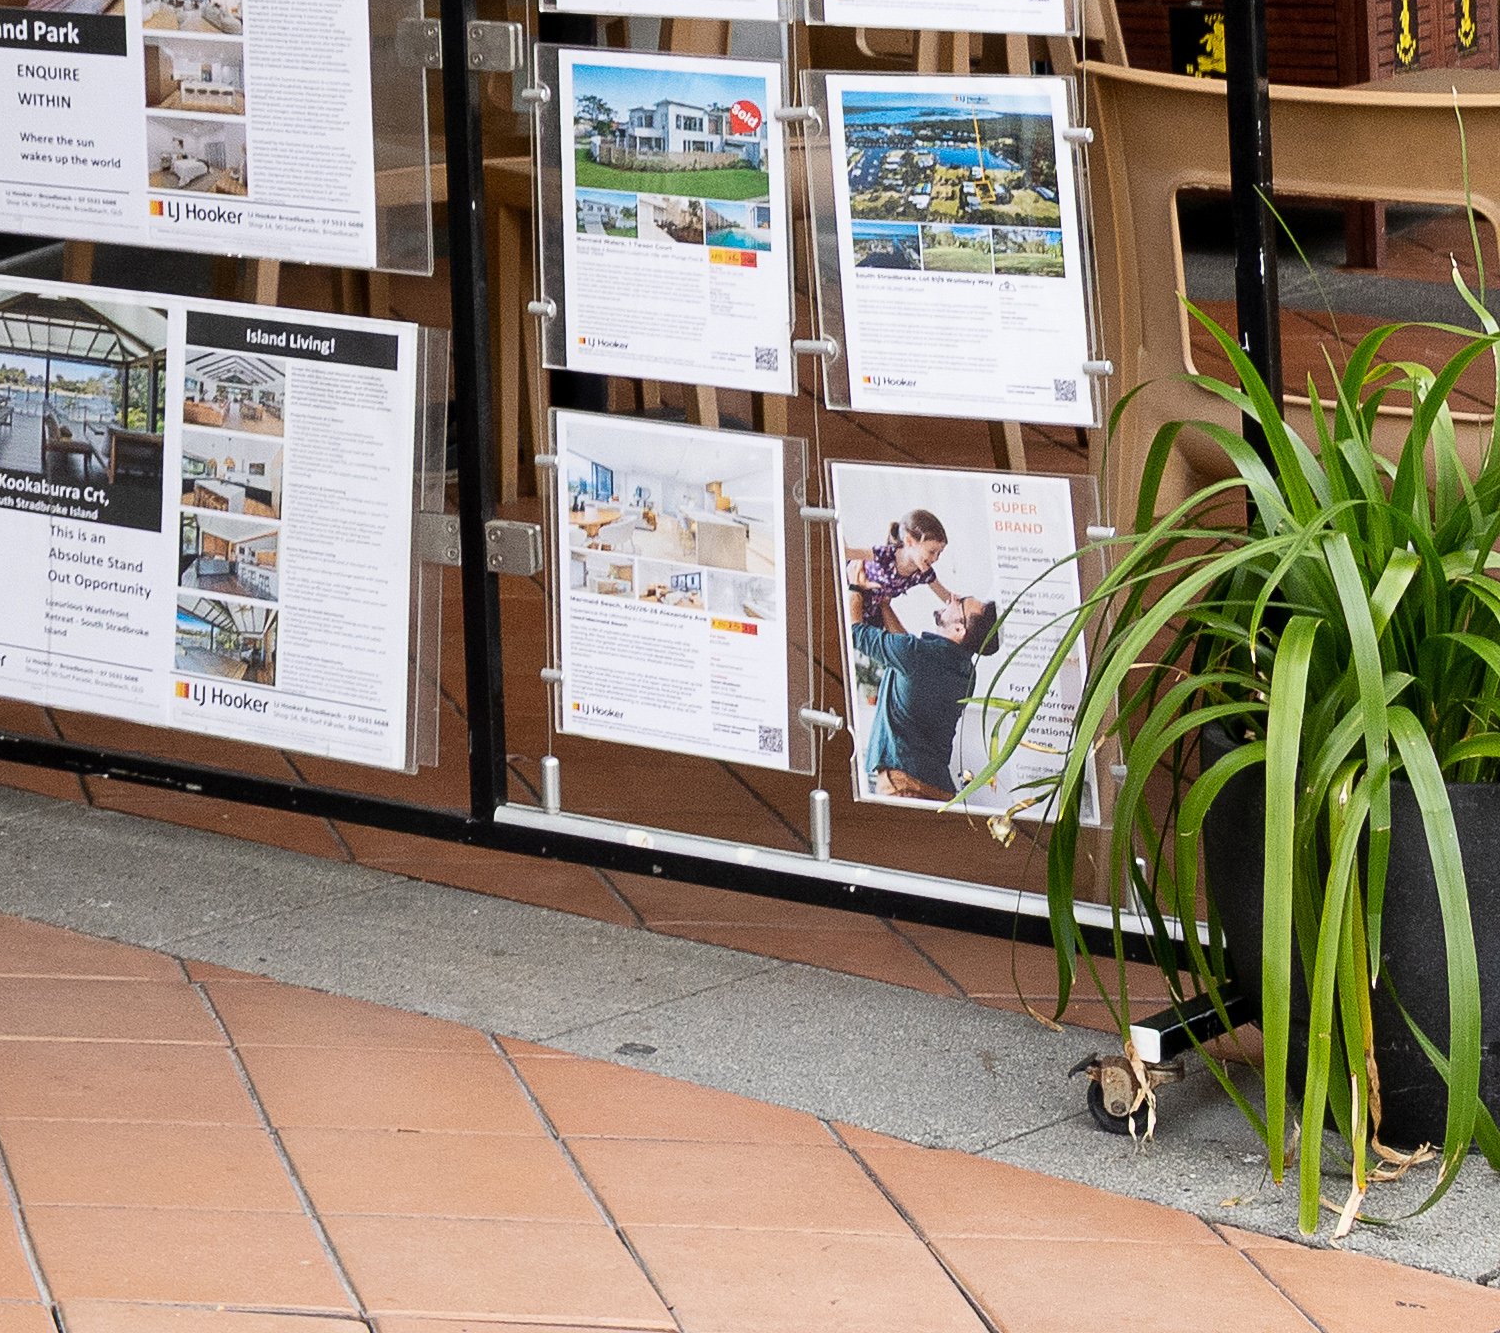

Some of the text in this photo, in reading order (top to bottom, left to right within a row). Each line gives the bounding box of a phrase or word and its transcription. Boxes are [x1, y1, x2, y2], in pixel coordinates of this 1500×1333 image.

[34, 21, 79, 44] Park
[17, 64, 80, 81] ENQUIRE
[18, 93, 71, 108] WITHIN
[731, 102, 758, 127] Sold
[20, 133, 53, 144] Where
[57, 135, 73, 146] the
[21, 152, 120, 168] wakes up the world
[168, 201, 243, 224] LJ Hooker
[247, 329, 335, 355] Island Living!
[84, 488, 109, 507] Crt,
[992, 484, 1020, 495] ONE
[16, 498, 67, 516] Stradbroke
[70, 506, 98, 520] Island
[993, 501, 1036, 515] SUPER
[50, 526, 105, 544] This is an
[995, 520, 1042, 534] BRAND
[49, 547, 143, 573] Absolute Stand
[48, 570, 151, 600] Out Opportunity
[85, 604, 128, 619] Waterfront
[44, 626, 67, 637] Island
[81, 617, 103, 629] South
[105, 621, 149, 636] Stradbroke
[1010, 683, 1025, 692] For
[193, 684, 269, 713] LJ Hooker
